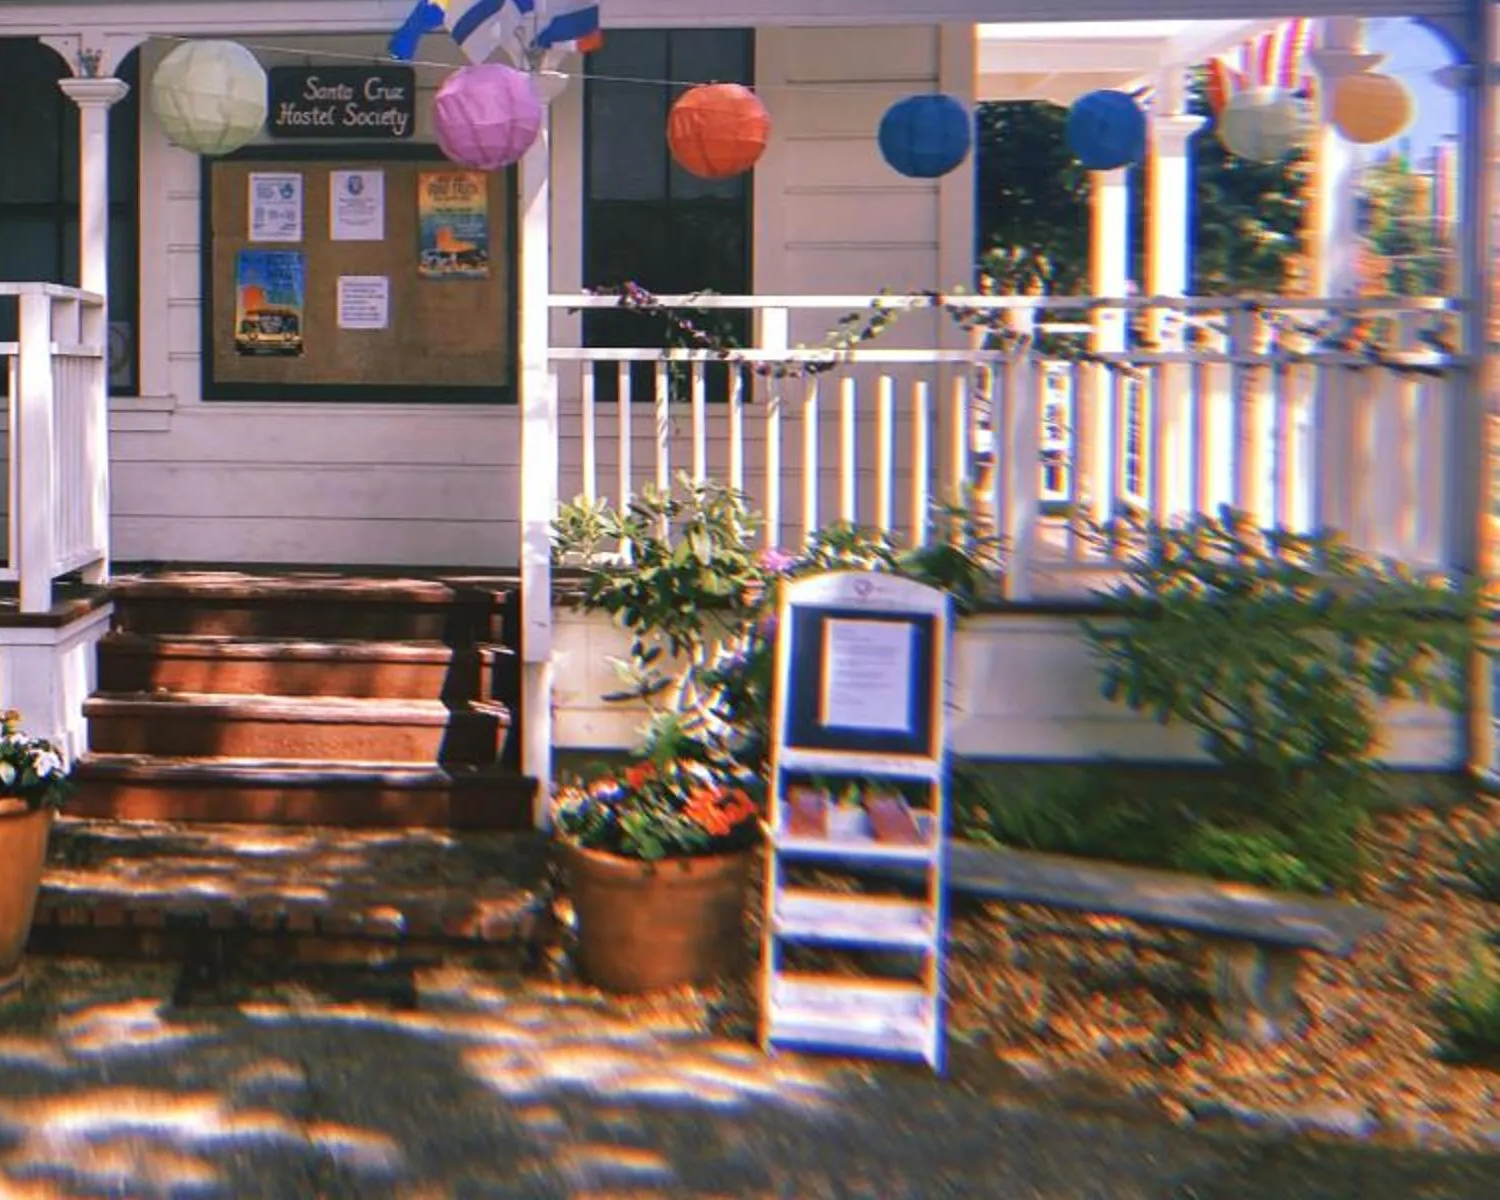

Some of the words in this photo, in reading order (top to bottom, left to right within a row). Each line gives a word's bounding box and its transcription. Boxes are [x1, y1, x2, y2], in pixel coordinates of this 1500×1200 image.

[302, 75, 354, 101] Santa
[364, 76, 405, 101] Cruz
[275, 101, 337, 126] Hostel
[342, 101, 410, 136] Society
